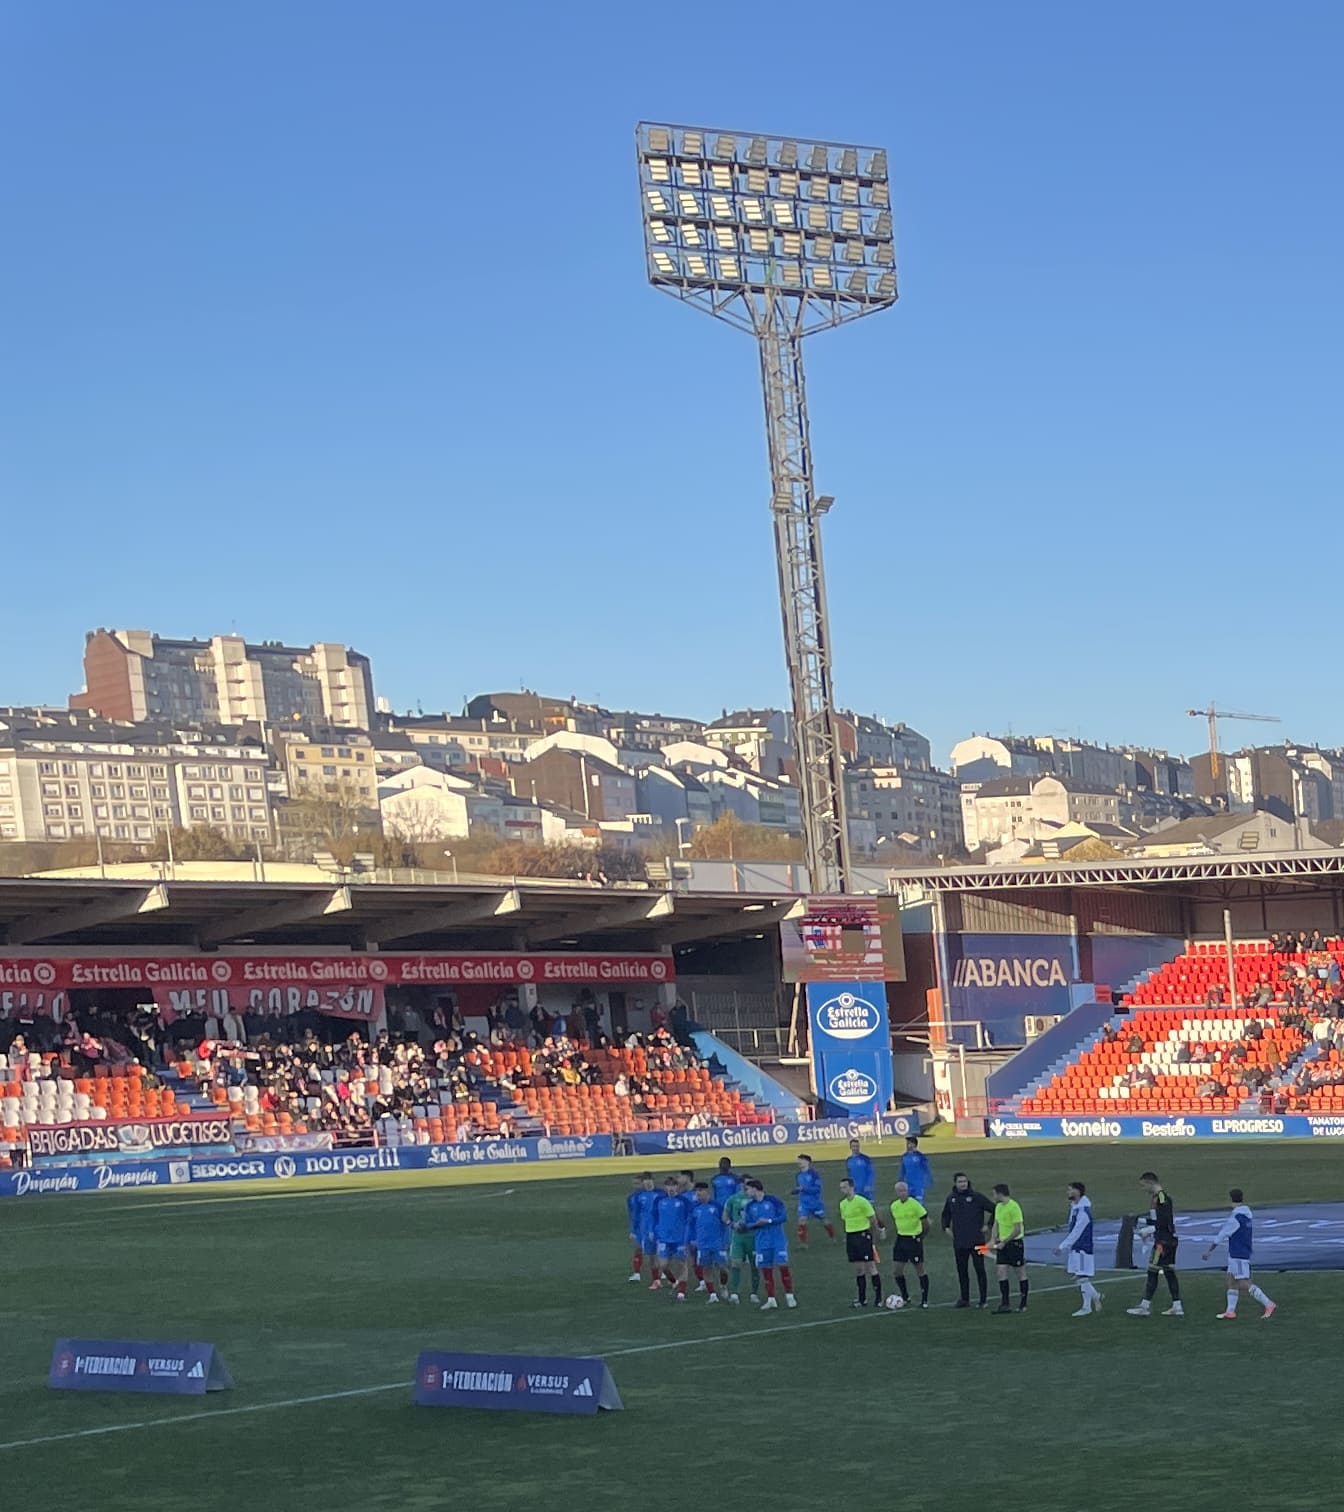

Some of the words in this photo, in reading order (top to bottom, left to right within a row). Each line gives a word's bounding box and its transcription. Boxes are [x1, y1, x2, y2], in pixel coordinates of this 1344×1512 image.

[72, 963, 142, 982] Estrella
[145, 962, 208, 981] Galicia
[243, 962, 307, 980] Estrella
[401, 962, 459, 979] Estrella
[461, 961, 513, 979] Galicia
[544, 962, 597, 978] Estrella
[599, 962, 648, 978] Galicia
[963, 957, 1067, 987] ABANCA
[827, 1007, 869, 1018] Estrella
[829, 1017, 868, 1028] Galicia
[29, 1126, 119, 1154] BRIGADAS
[667, 1132, 720, 1150] Estrella
[722, 1128, 769, 1146] Galicia
[797, 1124, 847, 1142] Estrella
[306, 1148, 400, 1174] norperfil
[527, 1374, 569, 1388] VERSUS
